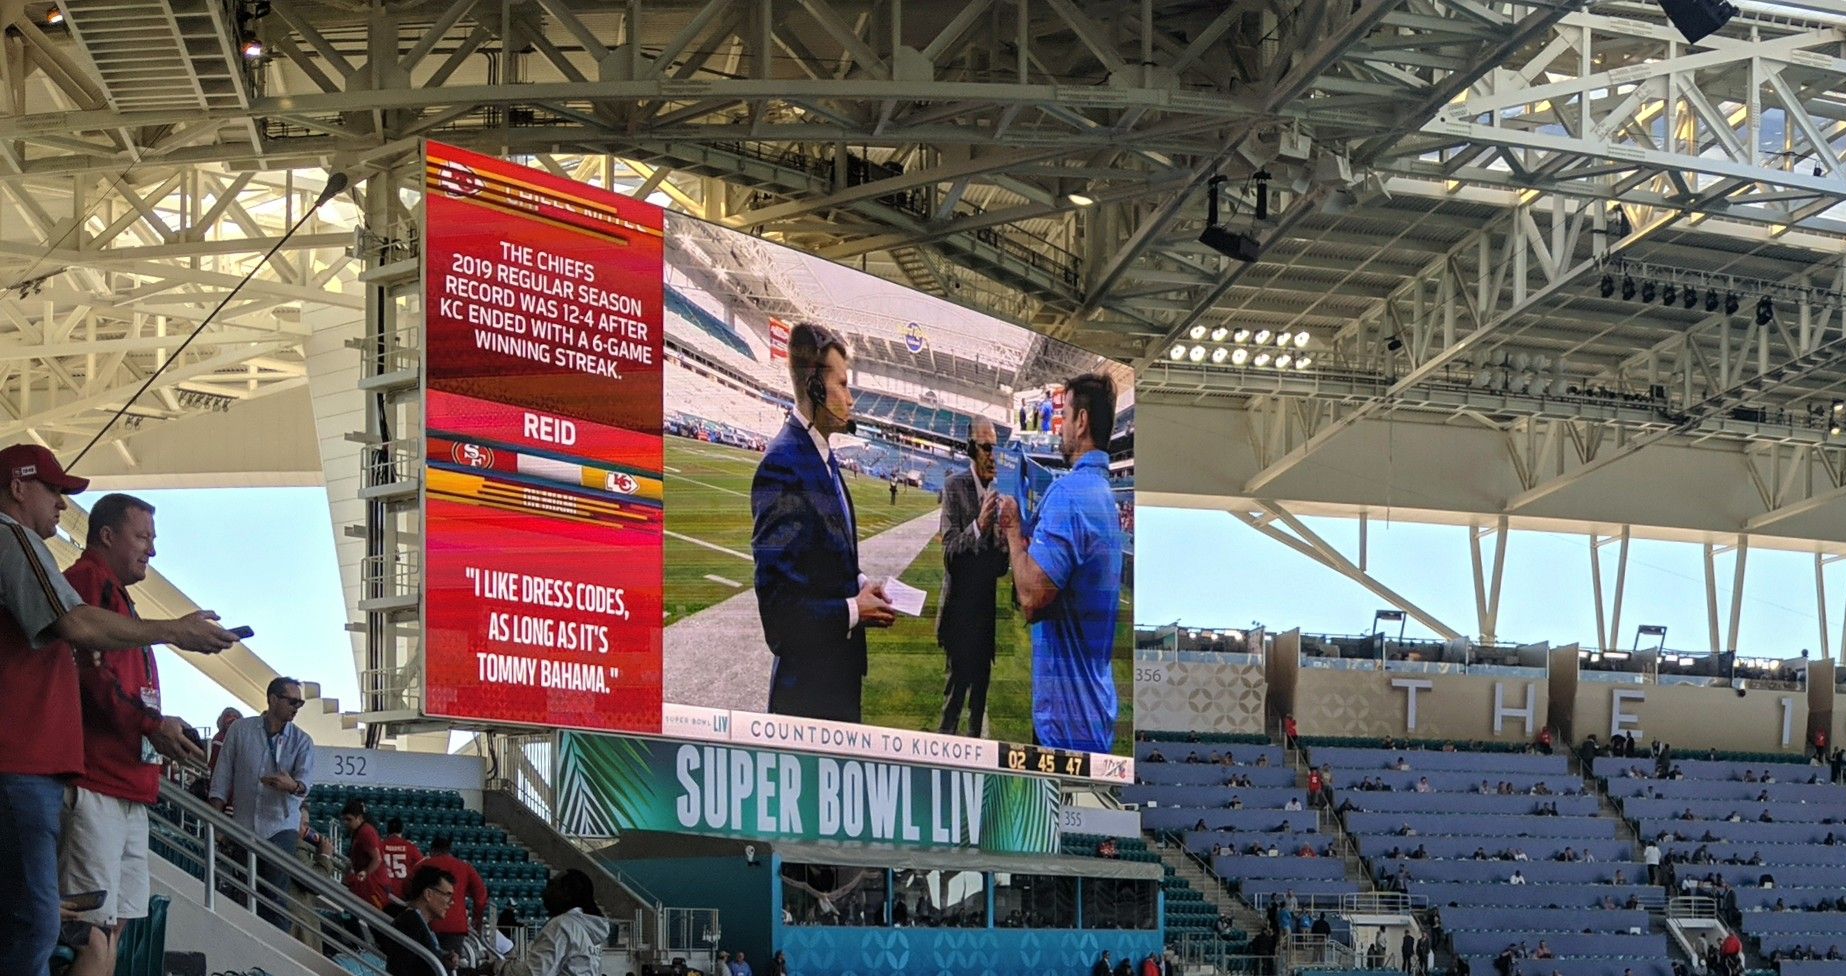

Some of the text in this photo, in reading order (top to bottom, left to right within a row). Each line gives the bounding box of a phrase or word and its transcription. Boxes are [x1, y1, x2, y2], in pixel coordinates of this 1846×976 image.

[500, 241, 595, 282] THE CHIEFS
[452, 254, 642, 317] 2019 REGULAR SEASON
[446, 275, 648, 341] RECORD WAS 12-4 AFTER
[440, 297, 652, 365] KC ENDED WITH A 6-GAME
[475, 329, 622, 379] WINNING STREAK.
[523, 412, 576, 446] REID
[466, 567, 629, 620] "I LIKE DRESS CODES,
[489, 612, 608, 654] AS LONG AS IT'S
[477, 652, 619, 694] TOMMY BAHAMA."
[1135, 668, 1162, 683] 356
[1391, 678, 1645, 738] THE
[750, 720, 983, 761] COUNTDOWN TO KICKOFF
[334, 755, 367, 776] 352
[1008, 752, 1026, 770] 02
[1037, 754, 1055, 773] 45
[1065, 757, 1082, 775] 47
[676, 743, 986, 846] SUPER BOWL LIV
[1064, 811, 1082, 827] 355
[384, 853, 407, 879] 15
